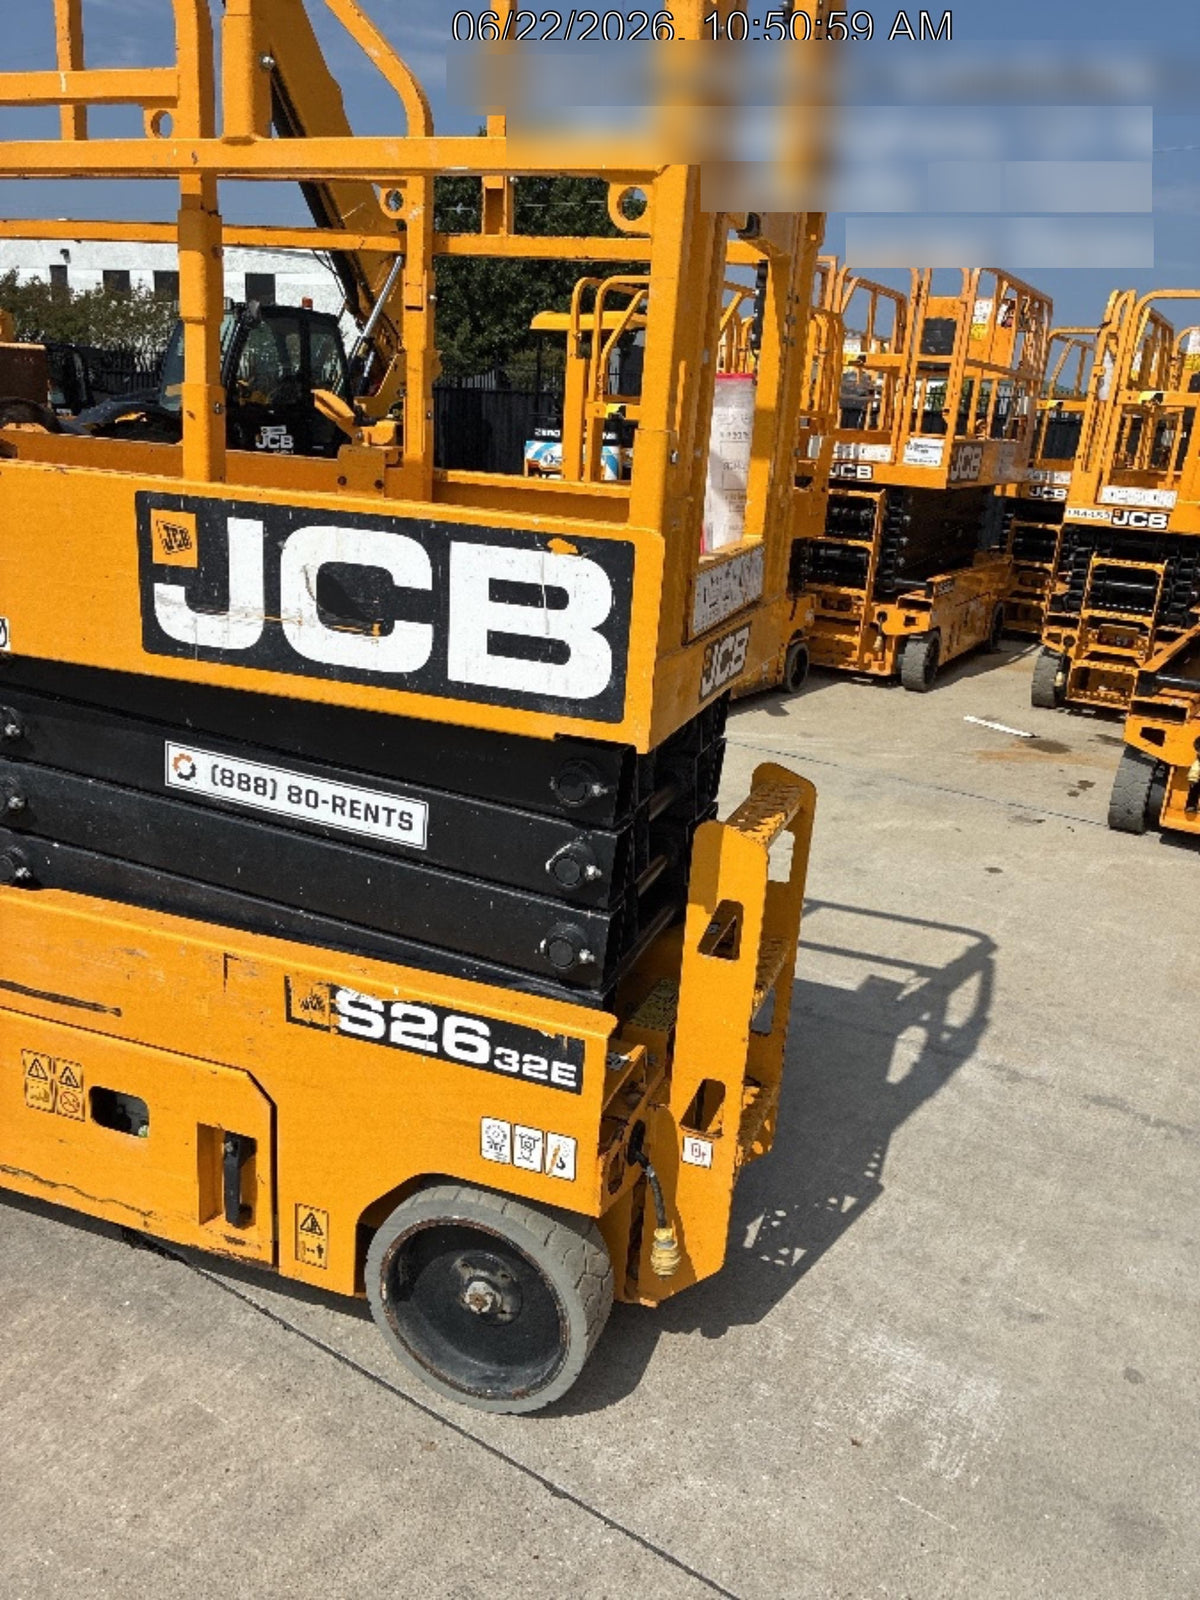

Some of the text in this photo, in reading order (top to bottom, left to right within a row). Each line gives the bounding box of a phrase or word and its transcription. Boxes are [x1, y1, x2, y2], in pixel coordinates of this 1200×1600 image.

[255, 434, 293, 449] JCB
[829, 463, 872, 479] JCB
[1112, 511, 1167, 529] JCB
[153, 517, 613, 700] JCB
[702, 627, 749, 698] JCB
[211, 764, 414, 832] (888) 80-RENTS
